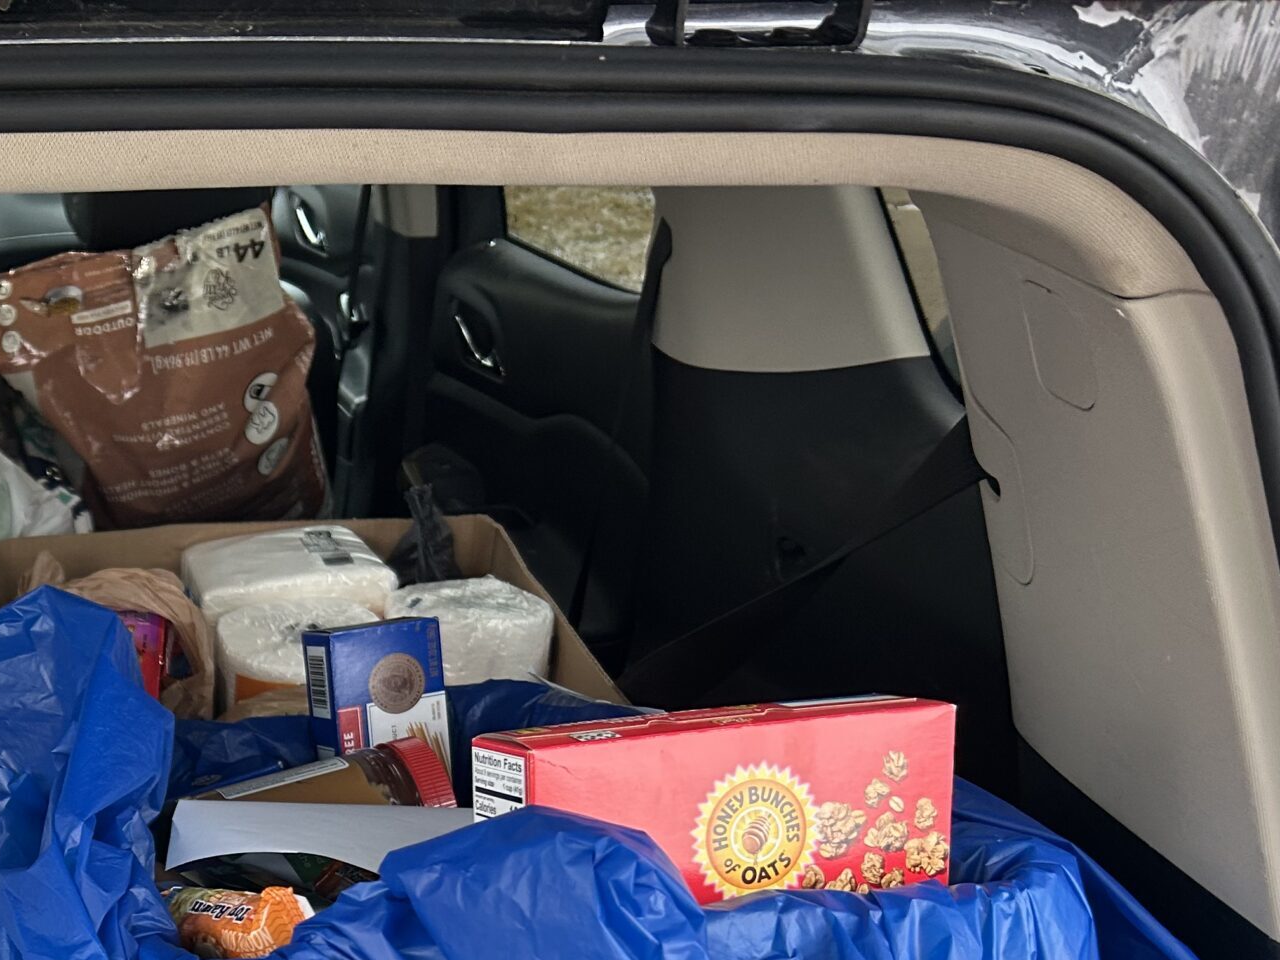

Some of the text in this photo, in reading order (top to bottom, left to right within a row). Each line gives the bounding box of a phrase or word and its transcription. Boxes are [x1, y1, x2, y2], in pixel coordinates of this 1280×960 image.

[216, 240, 265, 263] 44 LB
[75, 316, 136, 337] OUTDOOR
[474, 751, 522, 773] Nutrition Facts
[475, 800, 497, 816] Calories
[712, 786, 801, 852] HONEY BUNCHES
[724, 852, 792, 885] of OATS
